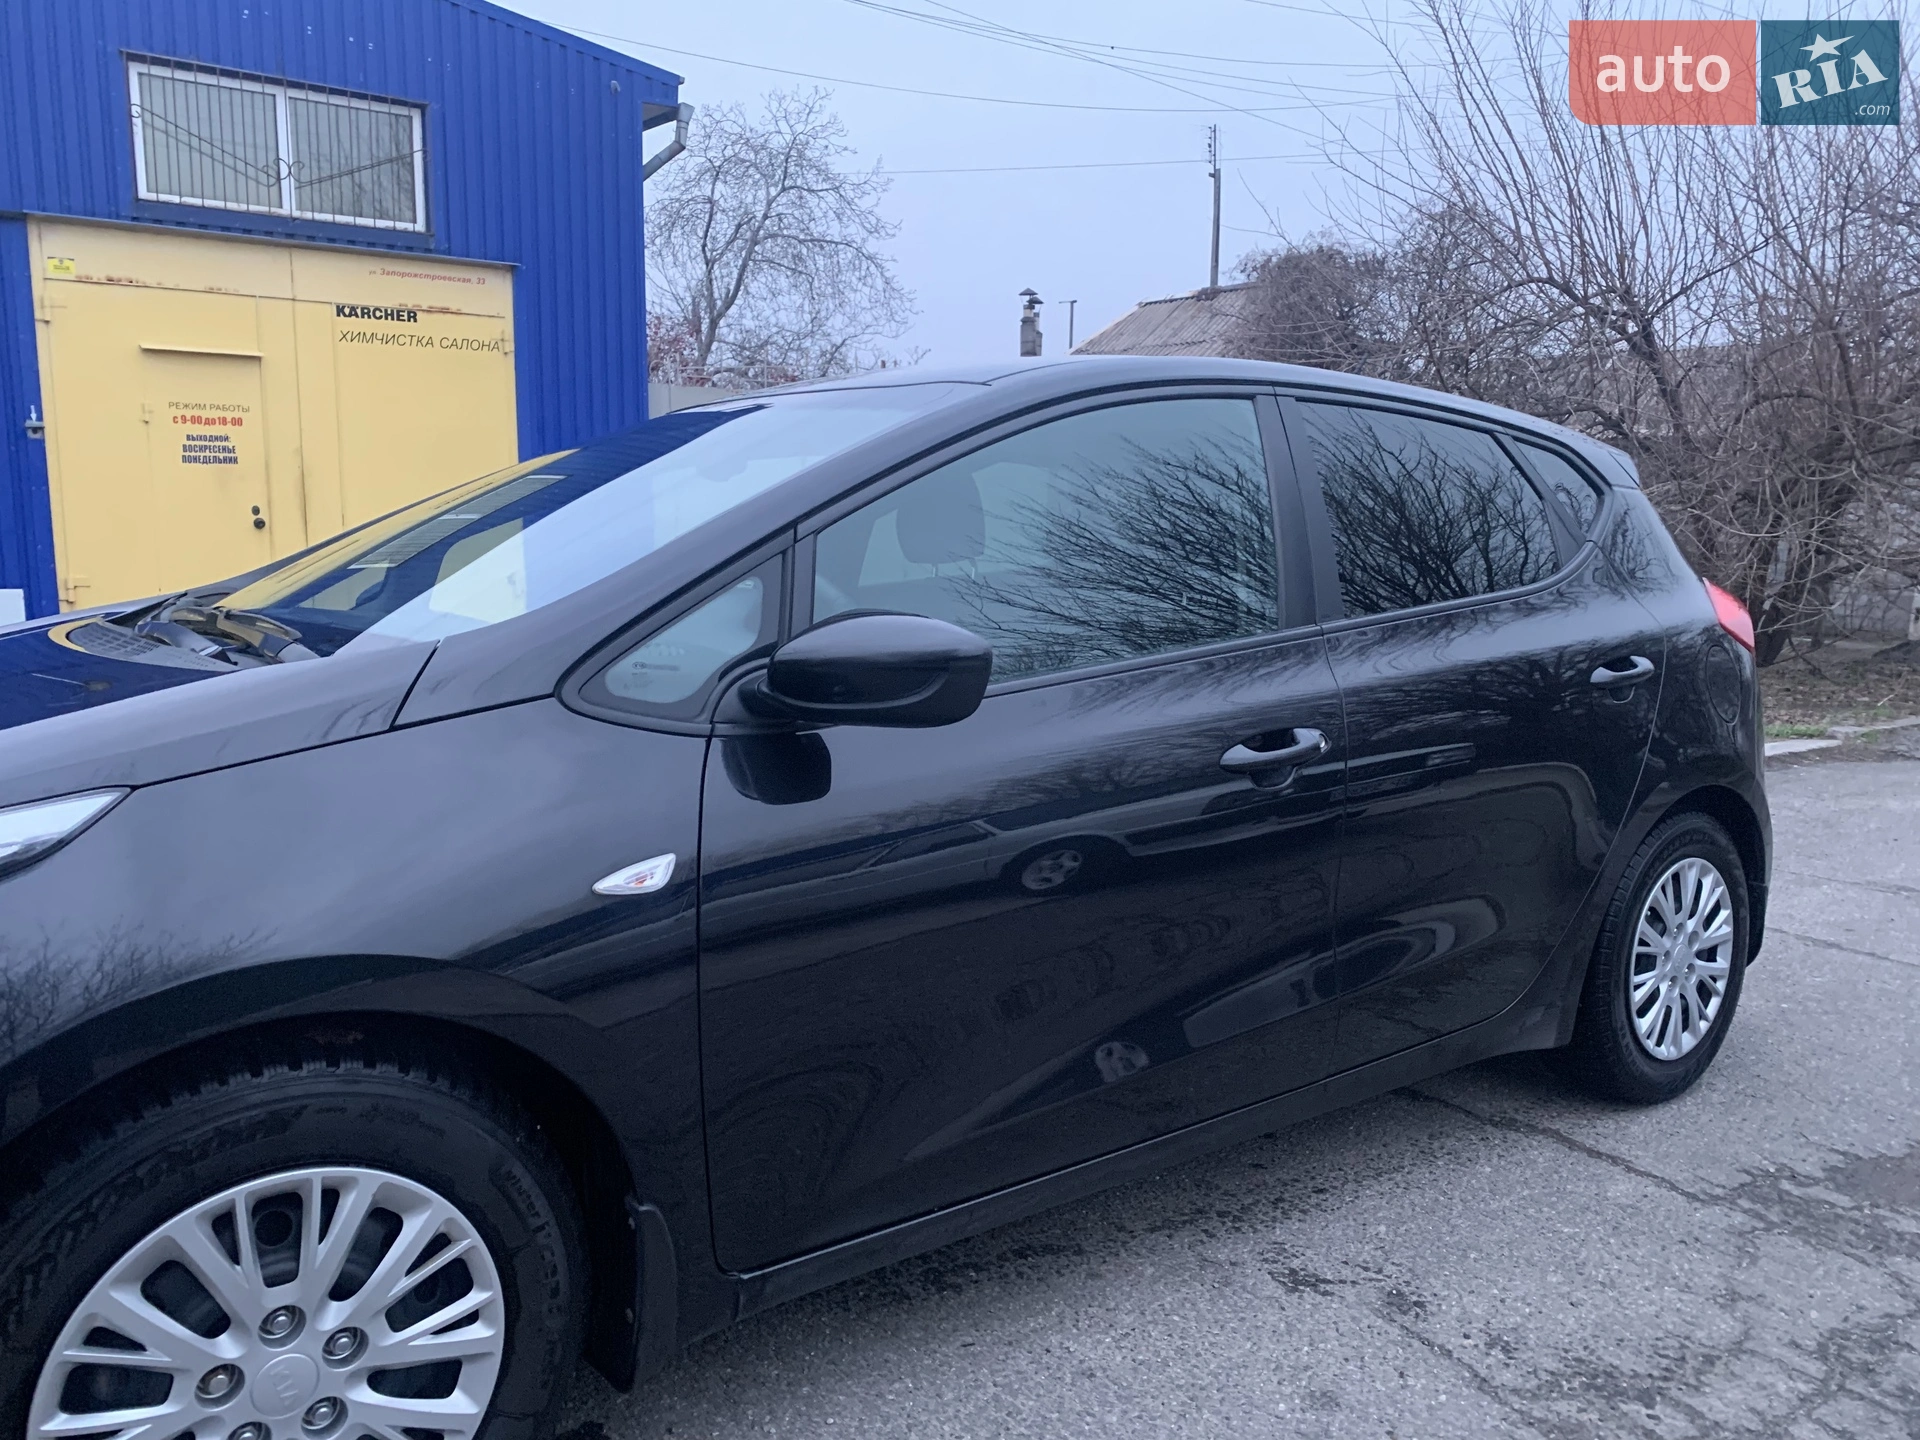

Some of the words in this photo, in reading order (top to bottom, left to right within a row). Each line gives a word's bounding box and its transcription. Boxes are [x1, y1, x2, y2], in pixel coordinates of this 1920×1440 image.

[476, 277, 486, 285] 33
[335, 304, 418, 323] KÄRCHER
[338, 330, 434, 348] ХИМЧИСТКА
[439, 337, 500, 352] САЛОНА
[168, 401, 207, 411] РЕЖИМ
[209, 403, 250, 413] РАБОТЫ
[180, 414, 203, 425] 9-00
[217, 416, 243, 427] 18-00
[182, 444, 236, 454] ВОСКРЕСЕНЬЕ
[181, 454, 239, 465] ПОНЕДЕЛЬНИК
